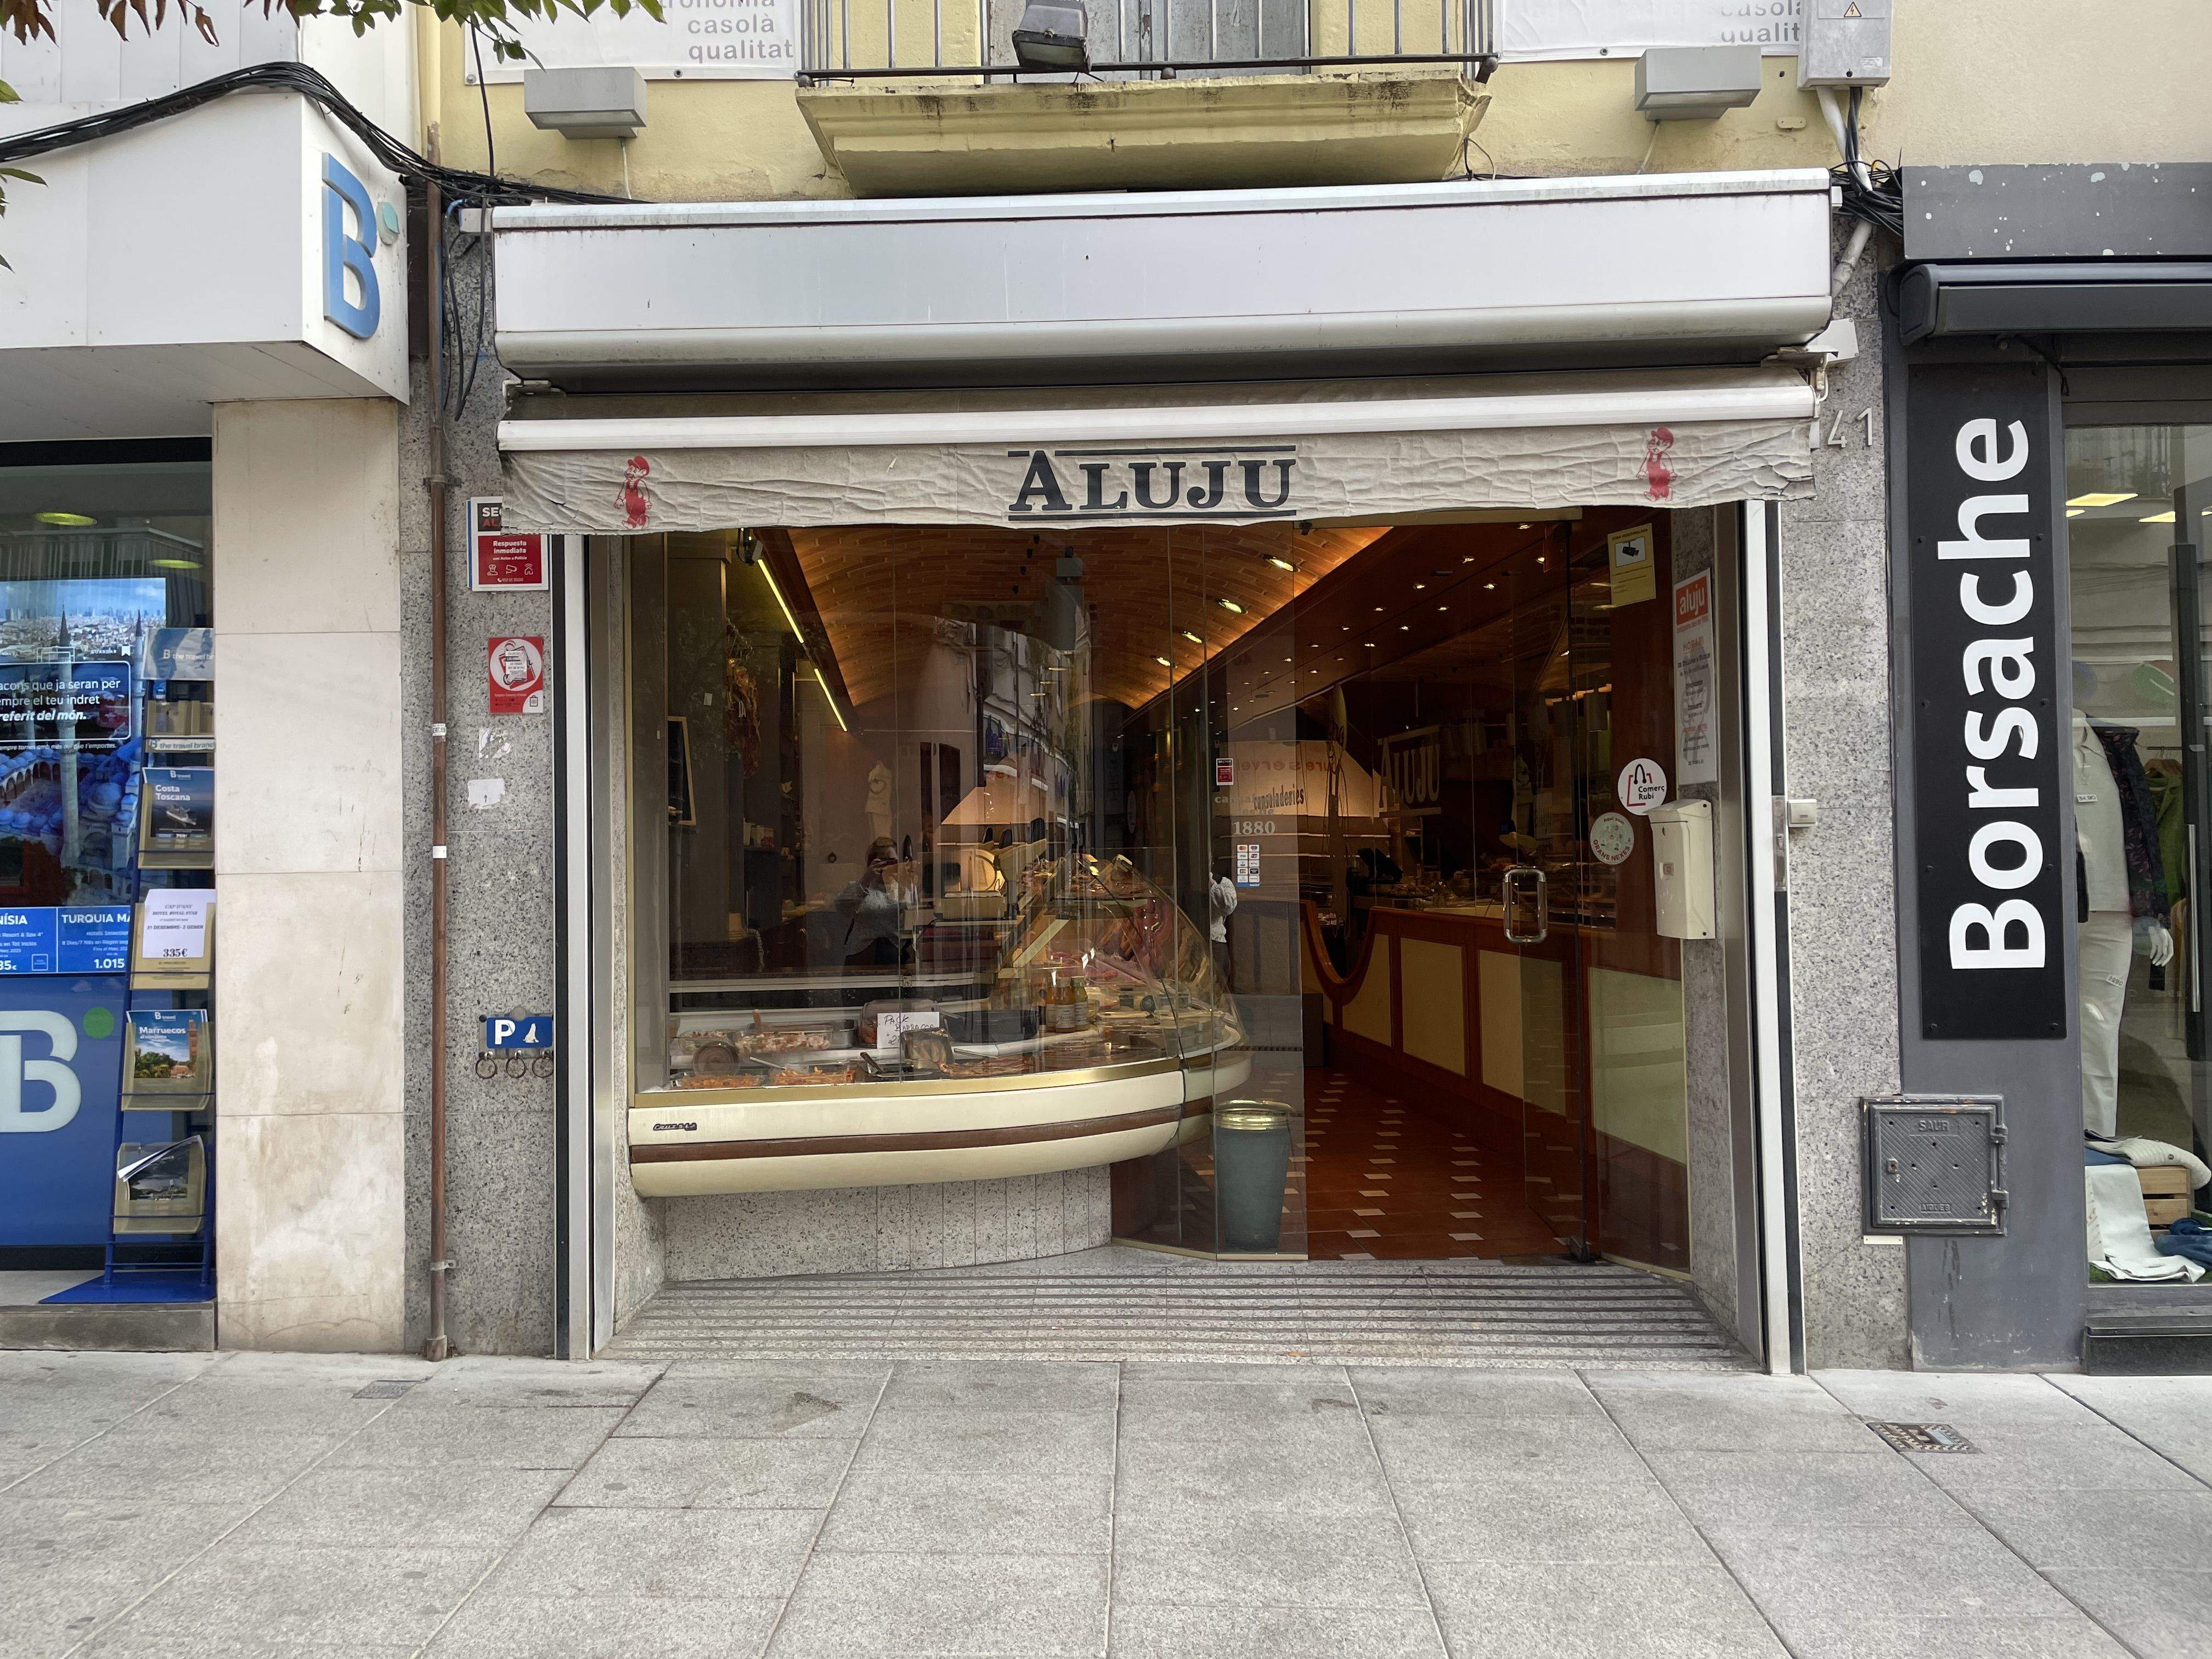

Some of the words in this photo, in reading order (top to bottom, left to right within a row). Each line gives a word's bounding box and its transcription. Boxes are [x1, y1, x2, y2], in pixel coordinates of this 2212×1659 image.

[688, 14, 774, 34] casolà
[689, 40, 793, 64] qualitat
[322, 153, 380, 340] B
[1827, 407, 1872, 448] 41
[1008, 450, 1296, 511] ALUJU
[1680, 584, 1705, 616] aluju
[32, 681, 53, 692] que
[55, 679, 65, 692] ja
[68, 681, 99, 690] seran
[101, 680, 121, 691] per
[1937, 417, 2045, 970] Borsache
[0, 698, 30, 708] mpre
[33, 695, 43, 706] el
[46, 696, 64, 706] teu
[66, 694, 100, 705] indret
[37, 709, 57, 721] del
[57, 708, 87, 720] món.
[156, 793, 191, 801] Toscana
[1233, 821, 1276, 835] 1880
[1593, 839, 1610, 860] GRANS
[61, 913, 114, 924] TURQUIA
[163, 948, 188, 957] 335€
[94, 958, 125, 969] 1.015
[884, 1014, 910, 1026] PACK
[495, 1019, 516, 1045] P
[1918, 1120, 1950, 1132] SAUR
